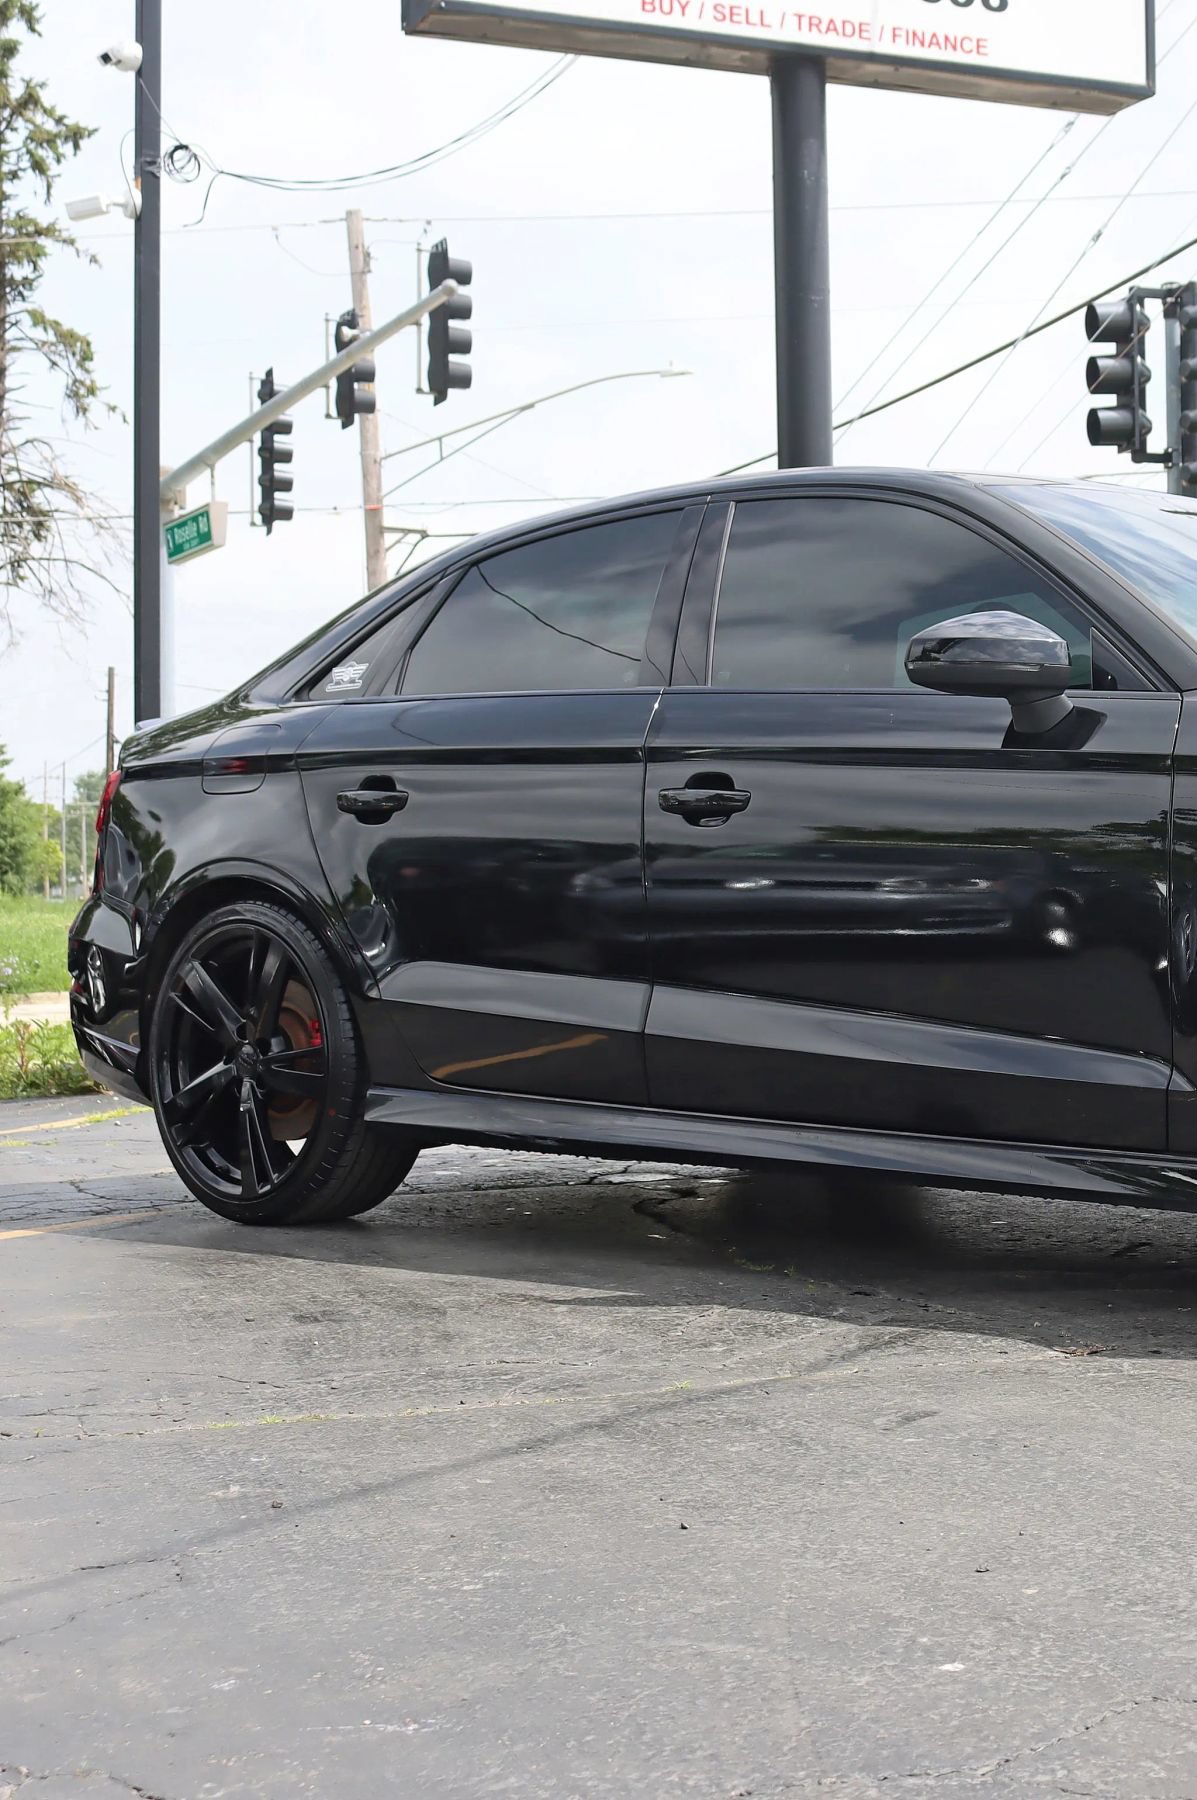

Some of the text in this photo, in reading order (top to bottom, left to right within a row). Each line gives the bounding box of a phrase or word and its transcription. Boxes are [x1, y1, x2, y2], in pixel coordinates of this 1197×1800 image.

[641, 0, 690, 17] BUY
[712, 3, 772, 28] SELL
[793, 13, 872, 41] TRADE
[891, 26, 990, 56] FINANCE
